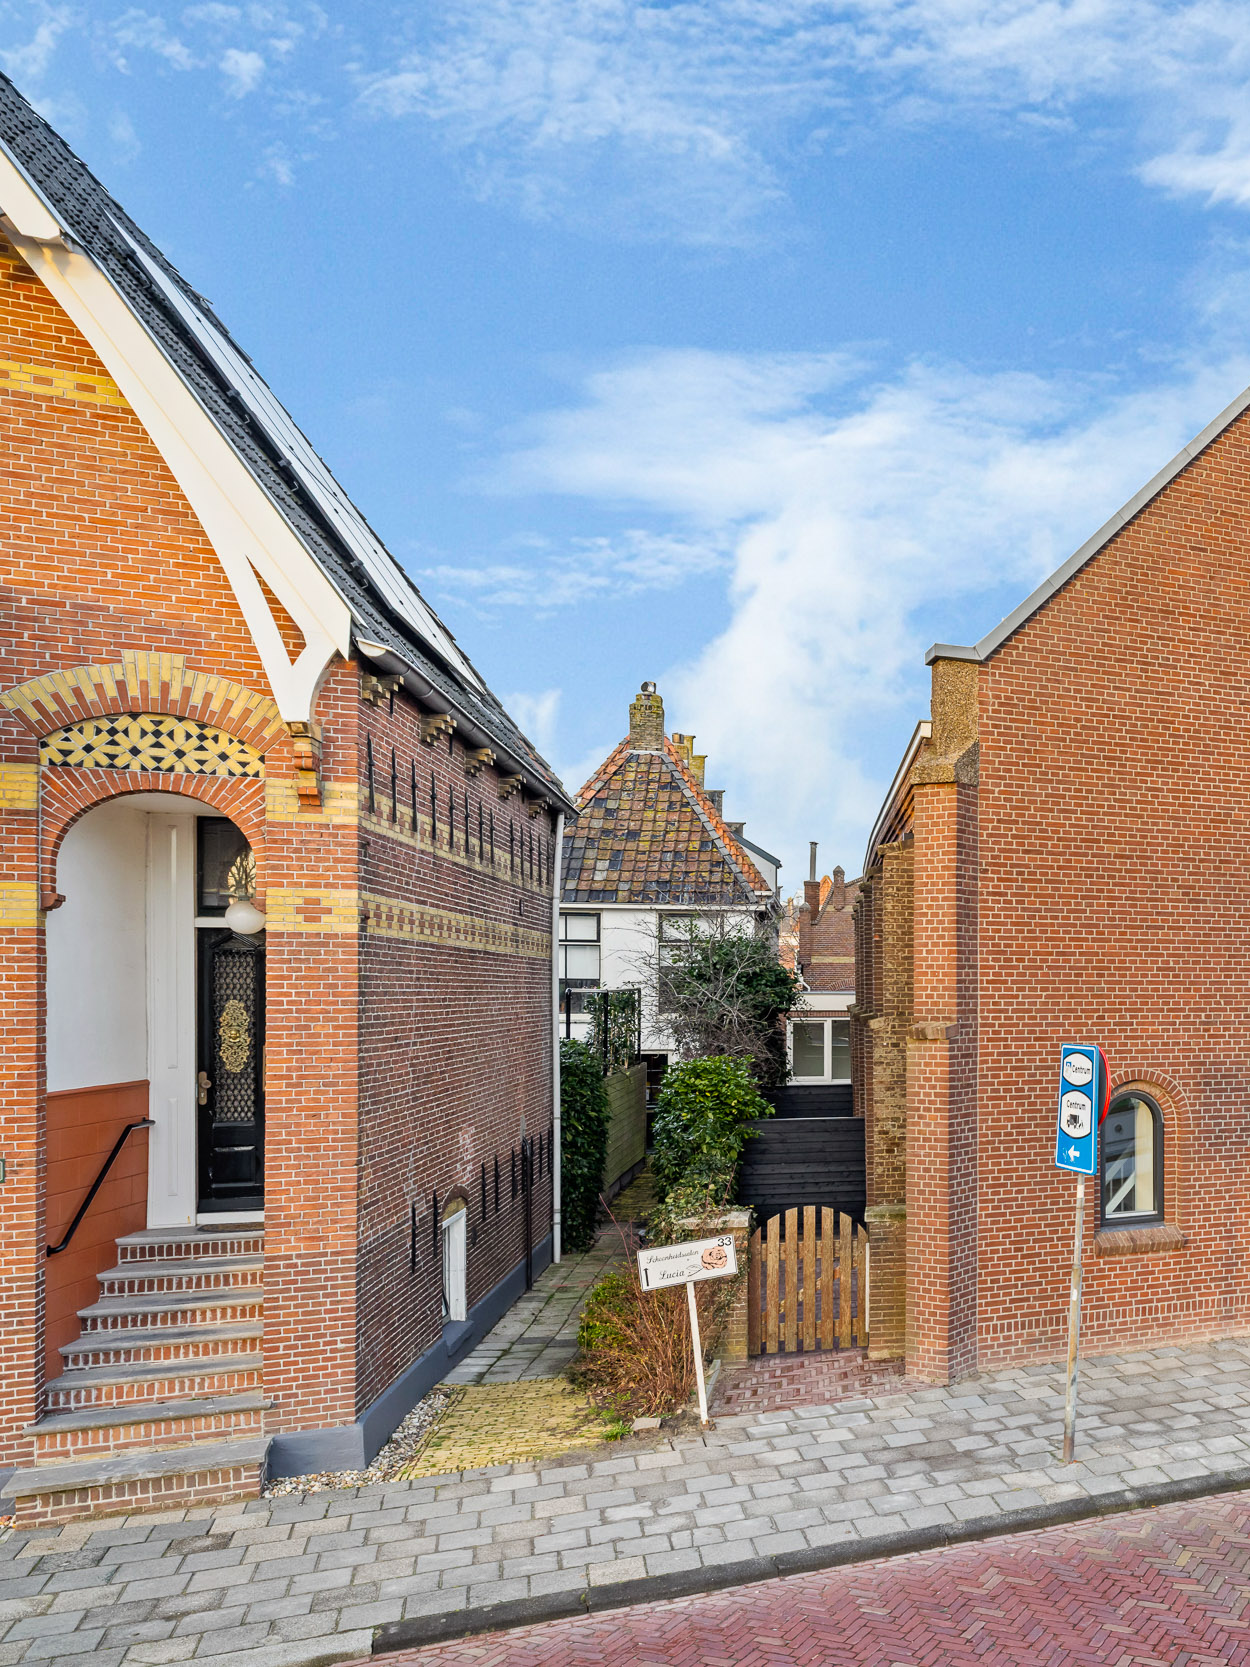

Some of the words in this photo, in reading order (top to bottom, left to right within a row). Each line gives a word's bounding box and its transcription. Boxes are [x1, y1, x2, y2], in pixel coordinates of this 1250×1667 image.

[1072, 1064, 1090, 1074] Centrum
[1067, 1099, 1086, 1110] Centrum
[717, 1236, 732, 1247] 33
[659, 1270, 685, 1280] Lucia
